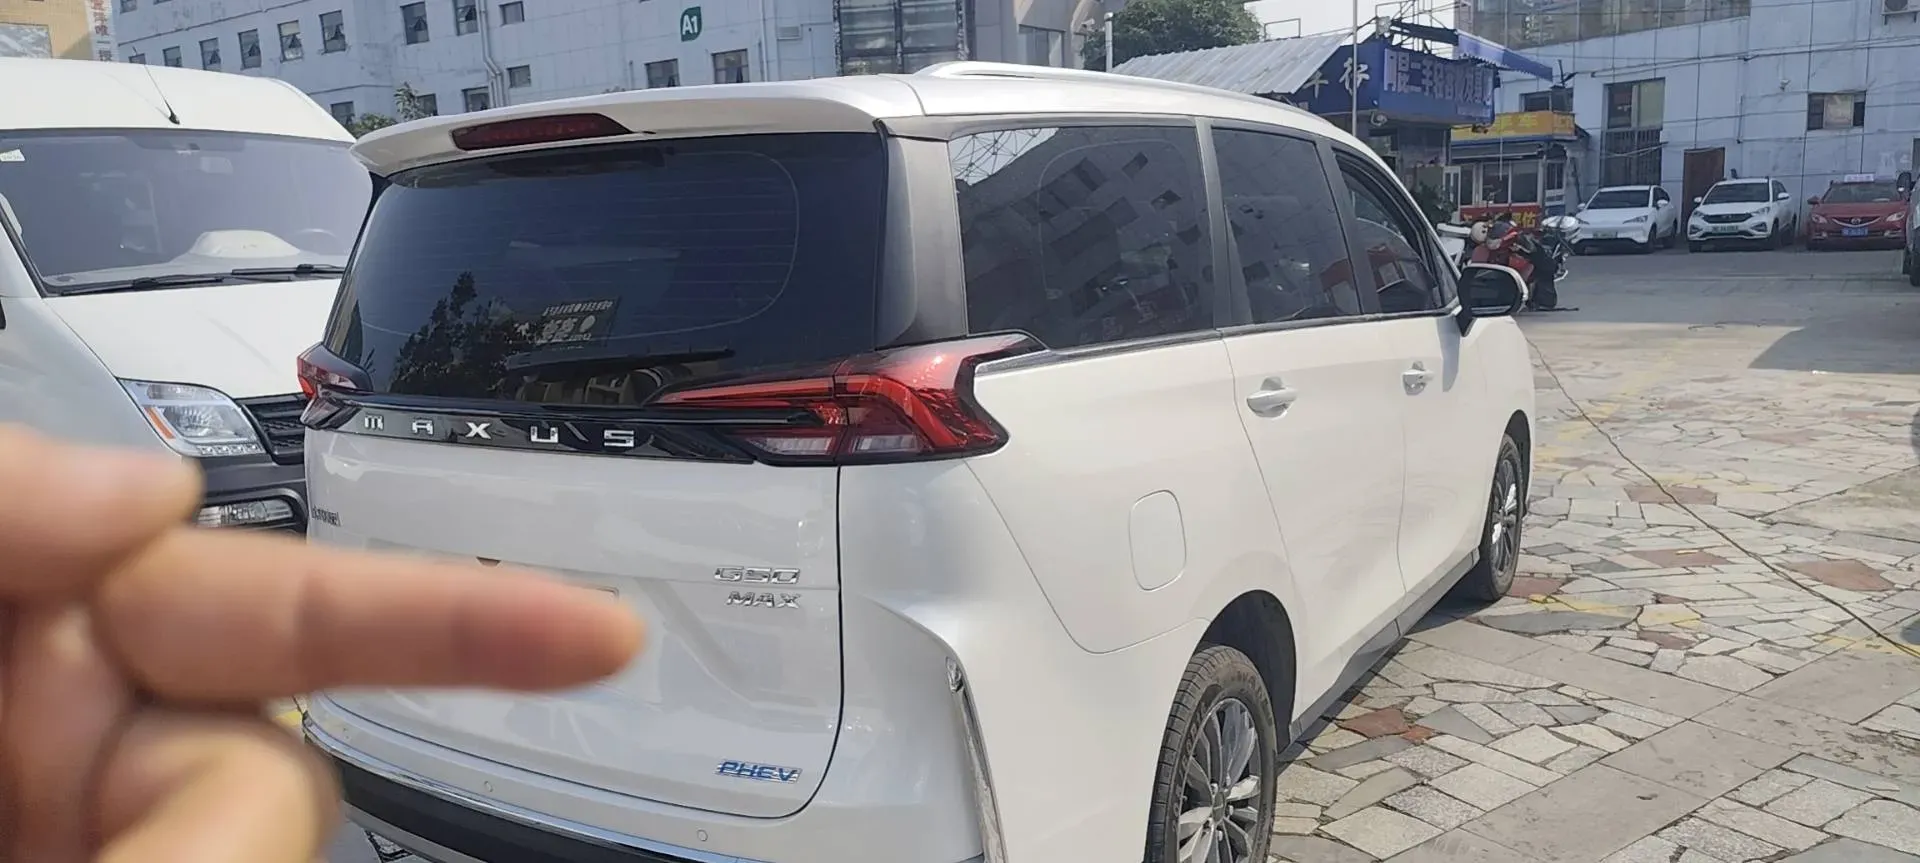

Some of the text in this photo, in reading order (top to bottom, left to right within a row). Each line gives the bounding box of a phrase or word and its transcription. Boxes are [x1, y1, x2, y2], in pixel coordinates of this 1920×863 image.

[682, 14, 698, 35] A1
[363, 414, 636, 447] MAXUS
[714, 567, 801, 584] G50
[725, 591, 801, 609] MAX
[716, 760, 802, 783] PHEV
